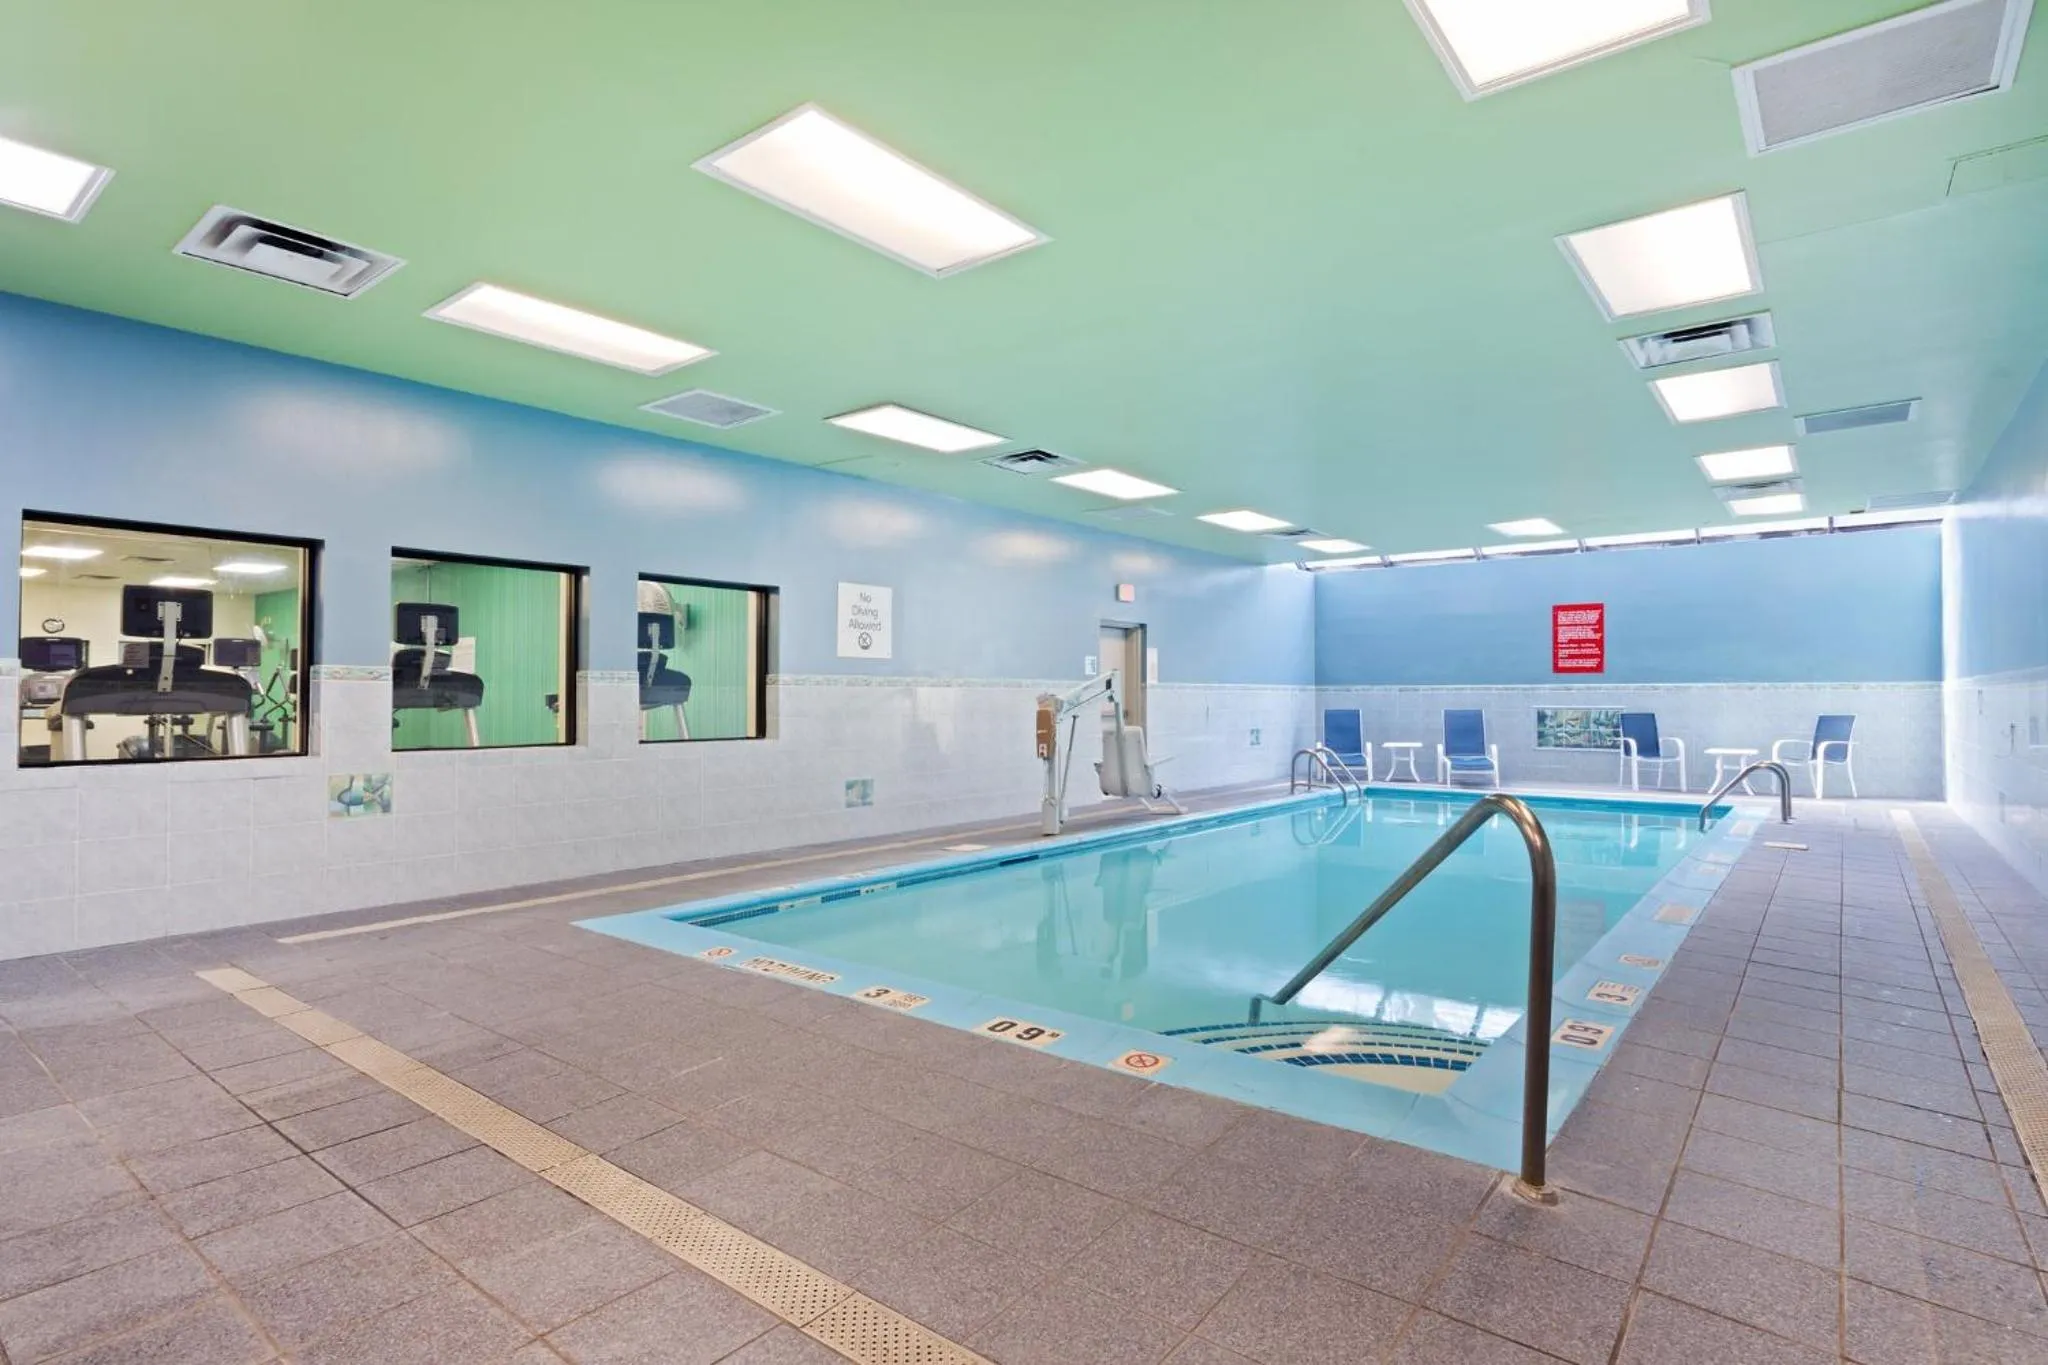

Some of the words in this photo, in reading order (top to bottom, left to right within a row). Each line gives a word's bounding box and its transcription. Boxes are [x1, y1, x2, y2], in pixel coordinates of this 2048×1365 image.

[860, 591, 872, 604] No
[851, 604, 879, 620] Diving
[848, 618, 882, 632] Allowed
